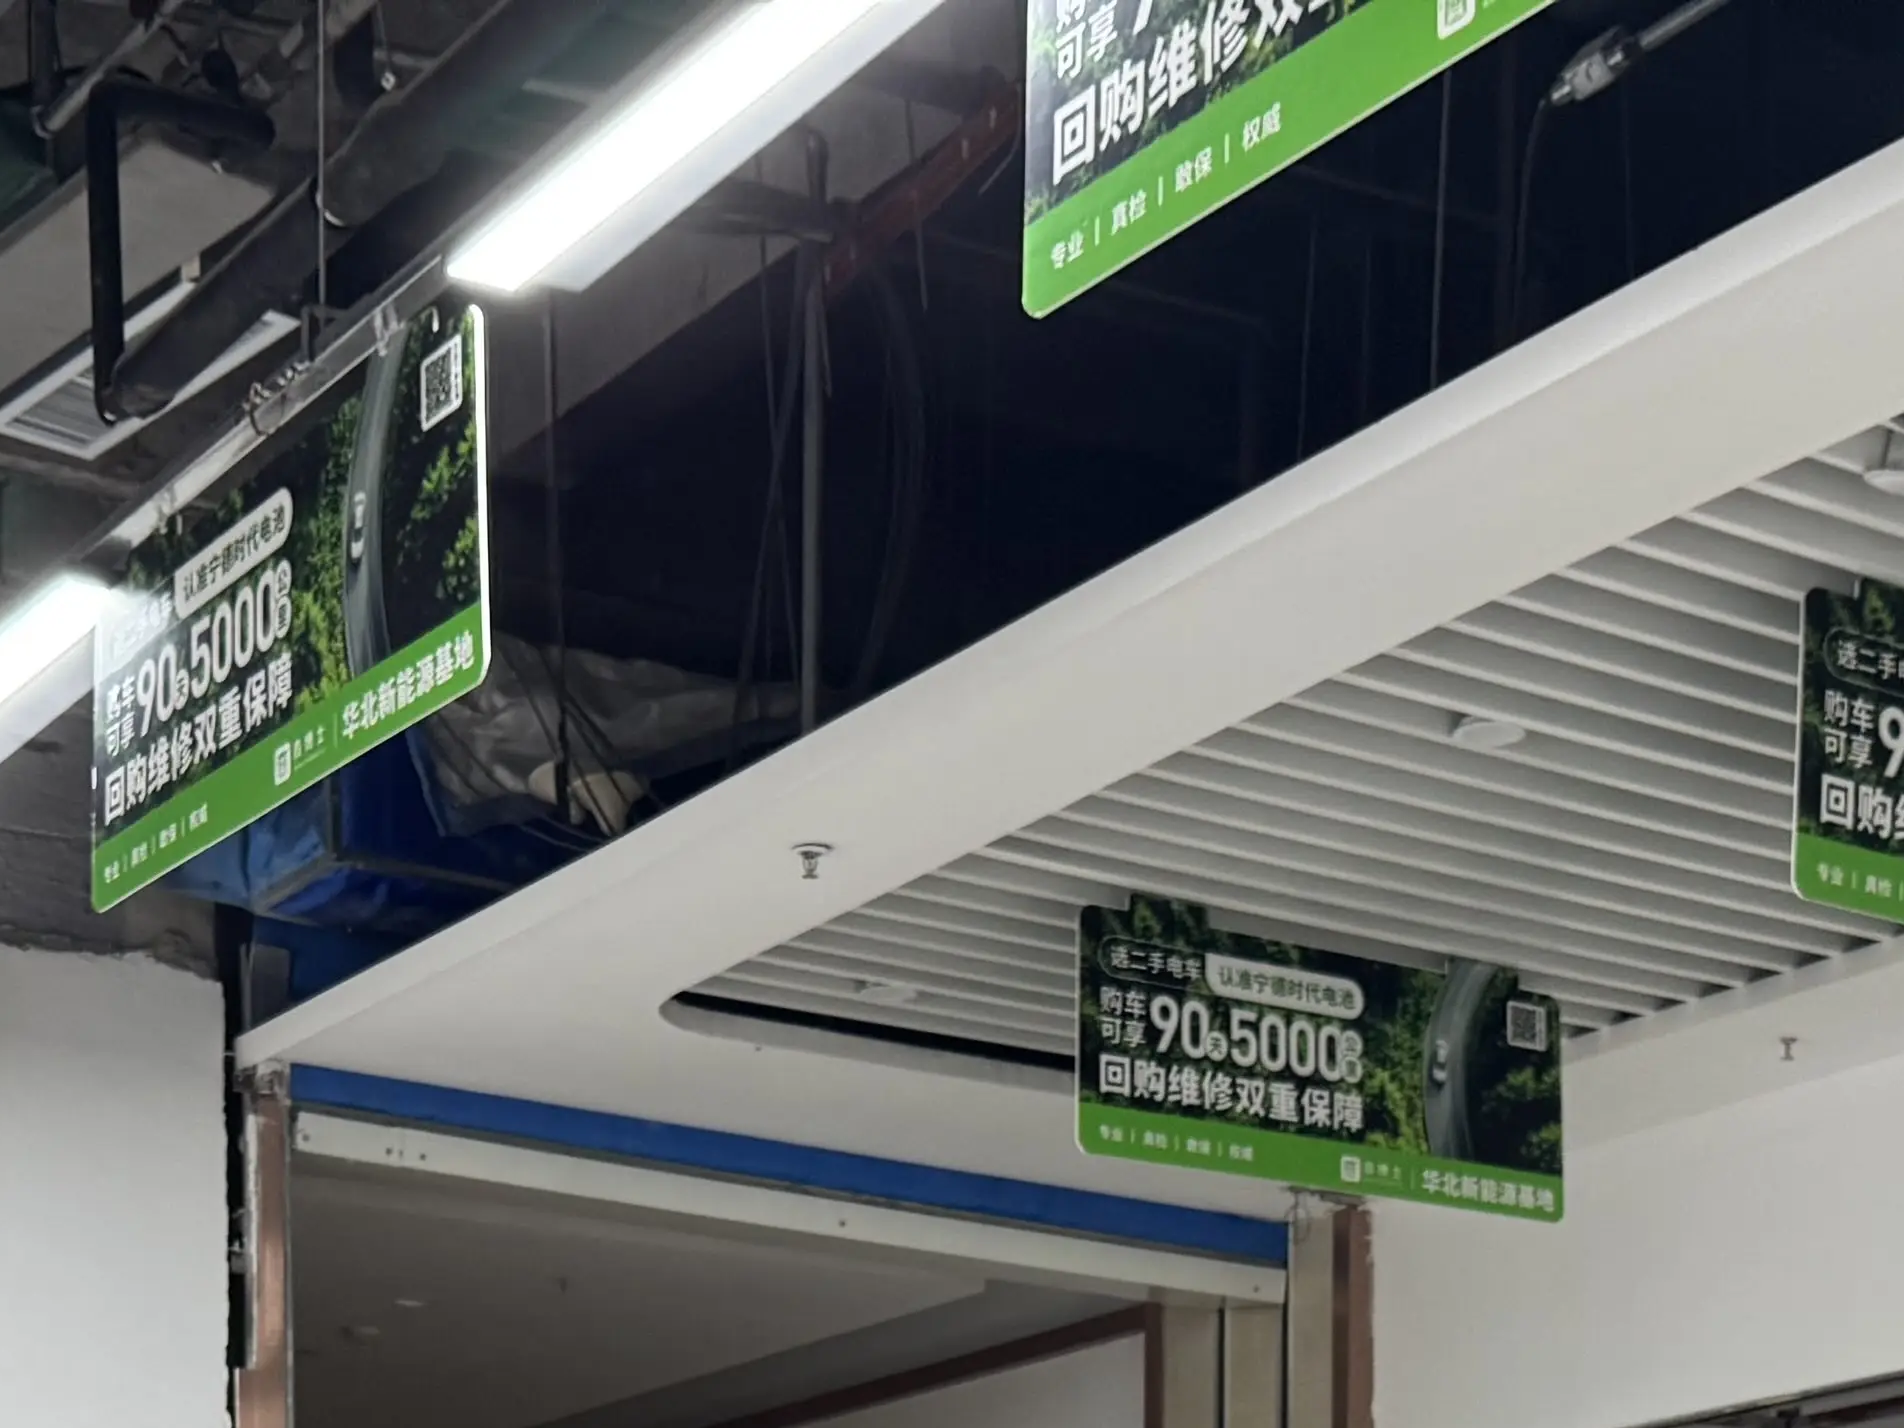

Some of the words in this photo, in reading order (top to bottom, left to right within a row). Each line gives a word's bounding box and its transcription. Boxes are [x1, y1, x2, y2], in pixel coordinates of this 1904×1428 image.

[1051, 230, 1084, 269] 专业
[1111, 189, 1146, 236] 真检
[1242, 101, 1280, 152] 权威
[342, 629, 475, 740] 华北新能源基地
[104, 652, 294, 826] 回购维修双重保障
[1824, 727, 1873, 769] 可享
[1100, 1016, 1146, 1047] 可享
[1098, 1055, 1364, 1133] 回购维修双重保障
